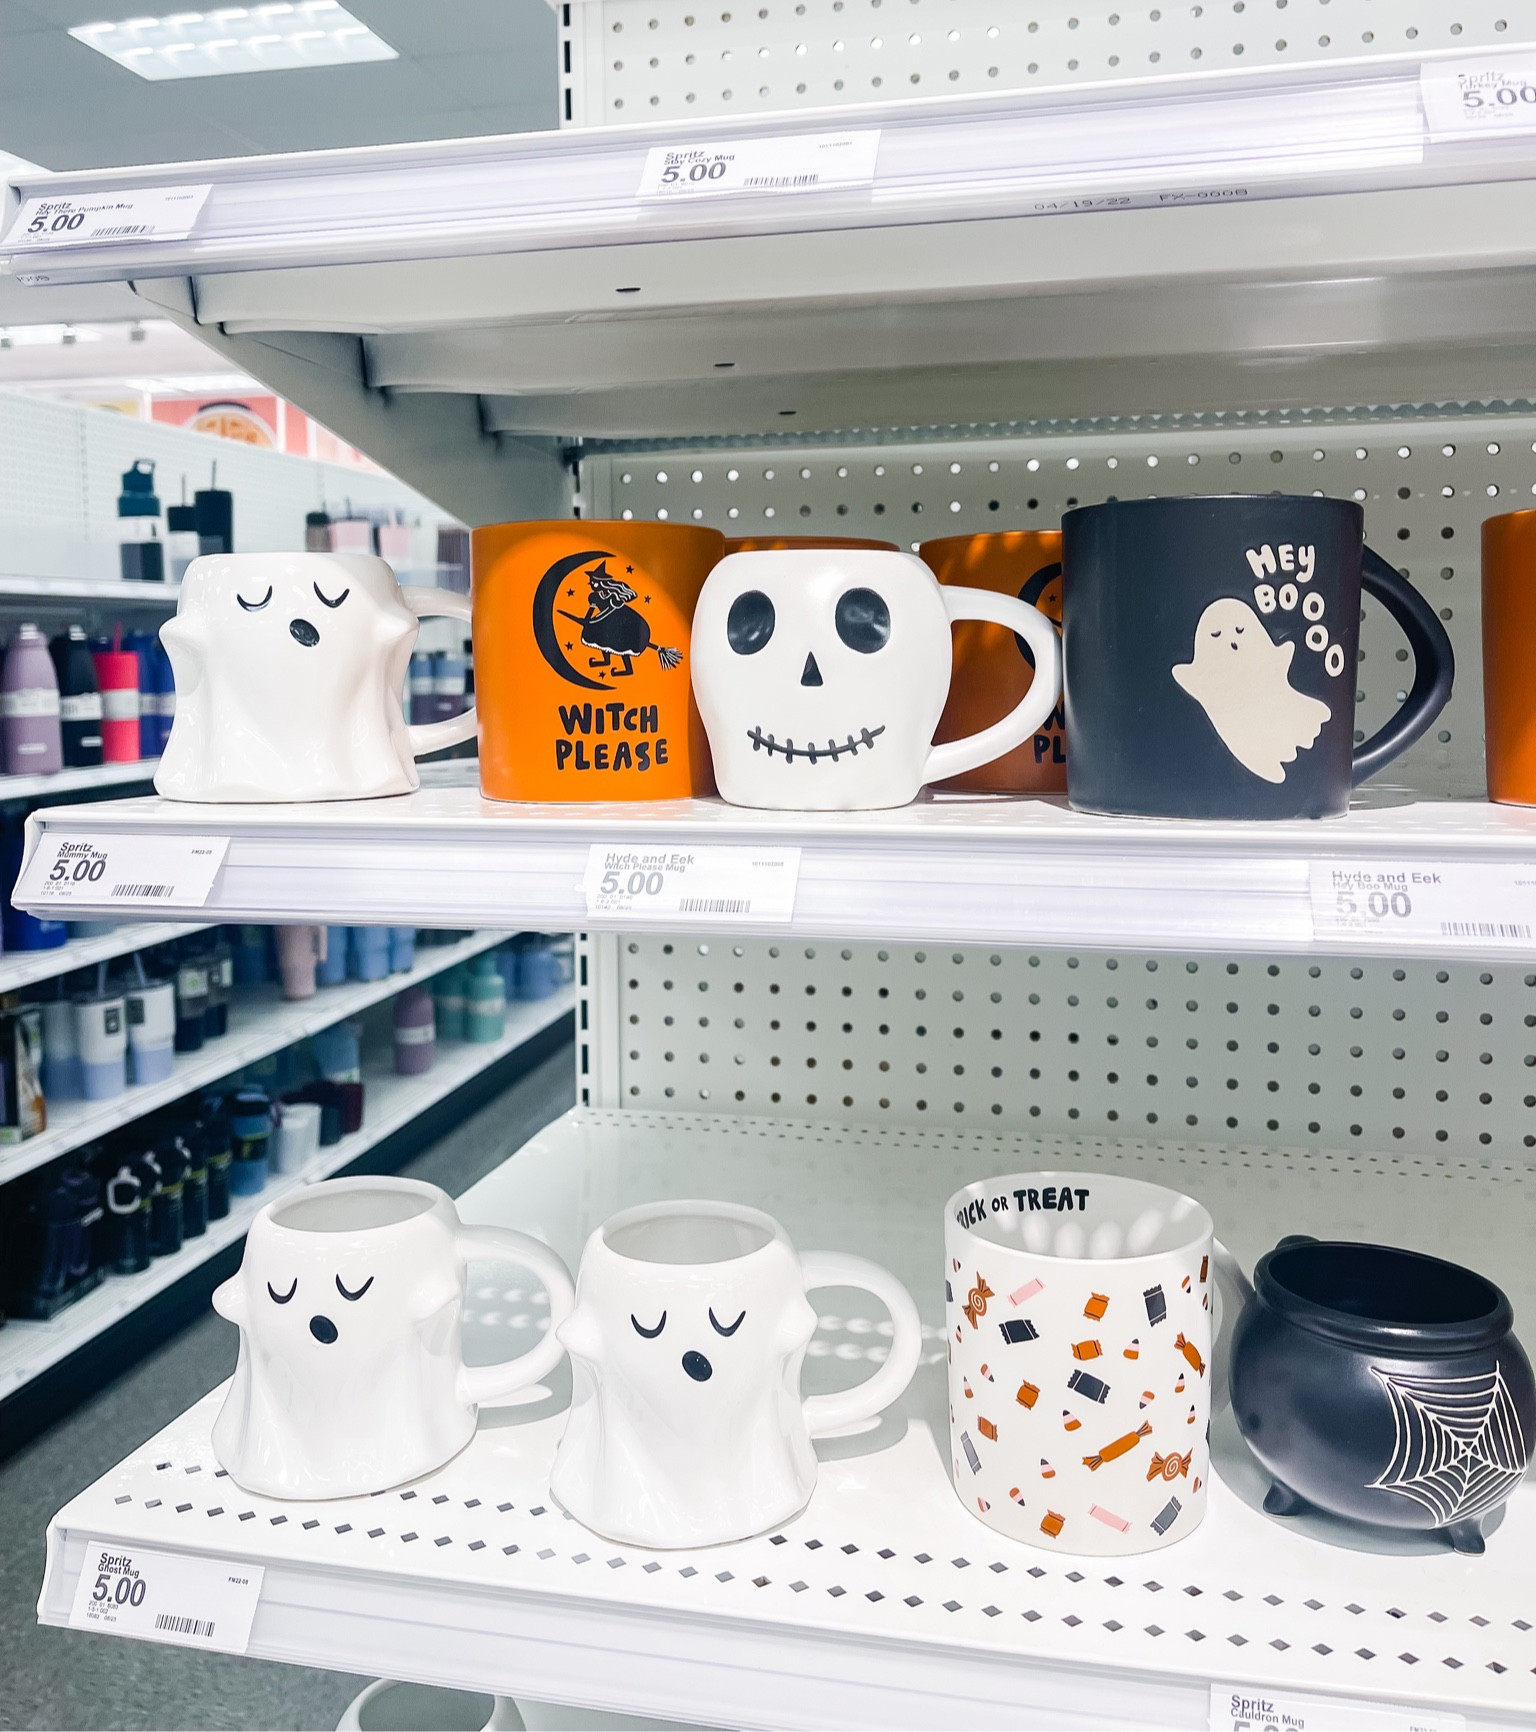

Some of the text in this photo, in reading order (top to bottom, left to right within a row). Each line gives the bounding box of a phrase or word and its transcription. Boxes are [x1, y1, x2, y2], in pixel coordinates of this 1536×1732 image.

[666, 150, 705, 161] Spritz
[661, 161, 726, 183] 5.00
[38, 202, 72, 212] Spritz
[78, 205, 114, 213] Pumpkin
[1034, 197, 1132, 210] 04/19/22
[28, 213, 85, 233] 5.00
[1245, 544, 1315, 583] HEY
[558, 702, 658, 735] WITCH
[555, 738, 669, 771] PLEASE
[56, 851, 108, 860] Mummy Mug
[60, 842, 94, 854] Spritz
[606, 853, 695, 865] Hyde and Eek
[49, 859, 106, 882] 5.00
[604, 862, 685, 873] Witch Please Mug
[600, 871, 664, 895] 5.00
[1332, 870, 1441, 884] Hyde and Eek
[1358, 882, 1380, 890] Boo
[1384, 882, 1408, 892] Mug
[956, 1187, 1089, 1229] RICK OR TREAT
[100, 1552, 132, 1568] Spritz
[97, 1563, 140, 1579] Ghost Mug
[92, 1574, 146, 1607] 5.00
[1231, 1695, 1274, 1714] Spritz
[1230, 1707, 1279, 1724] Cauldron
[1282, 1714, 1305, 1729] Mug
